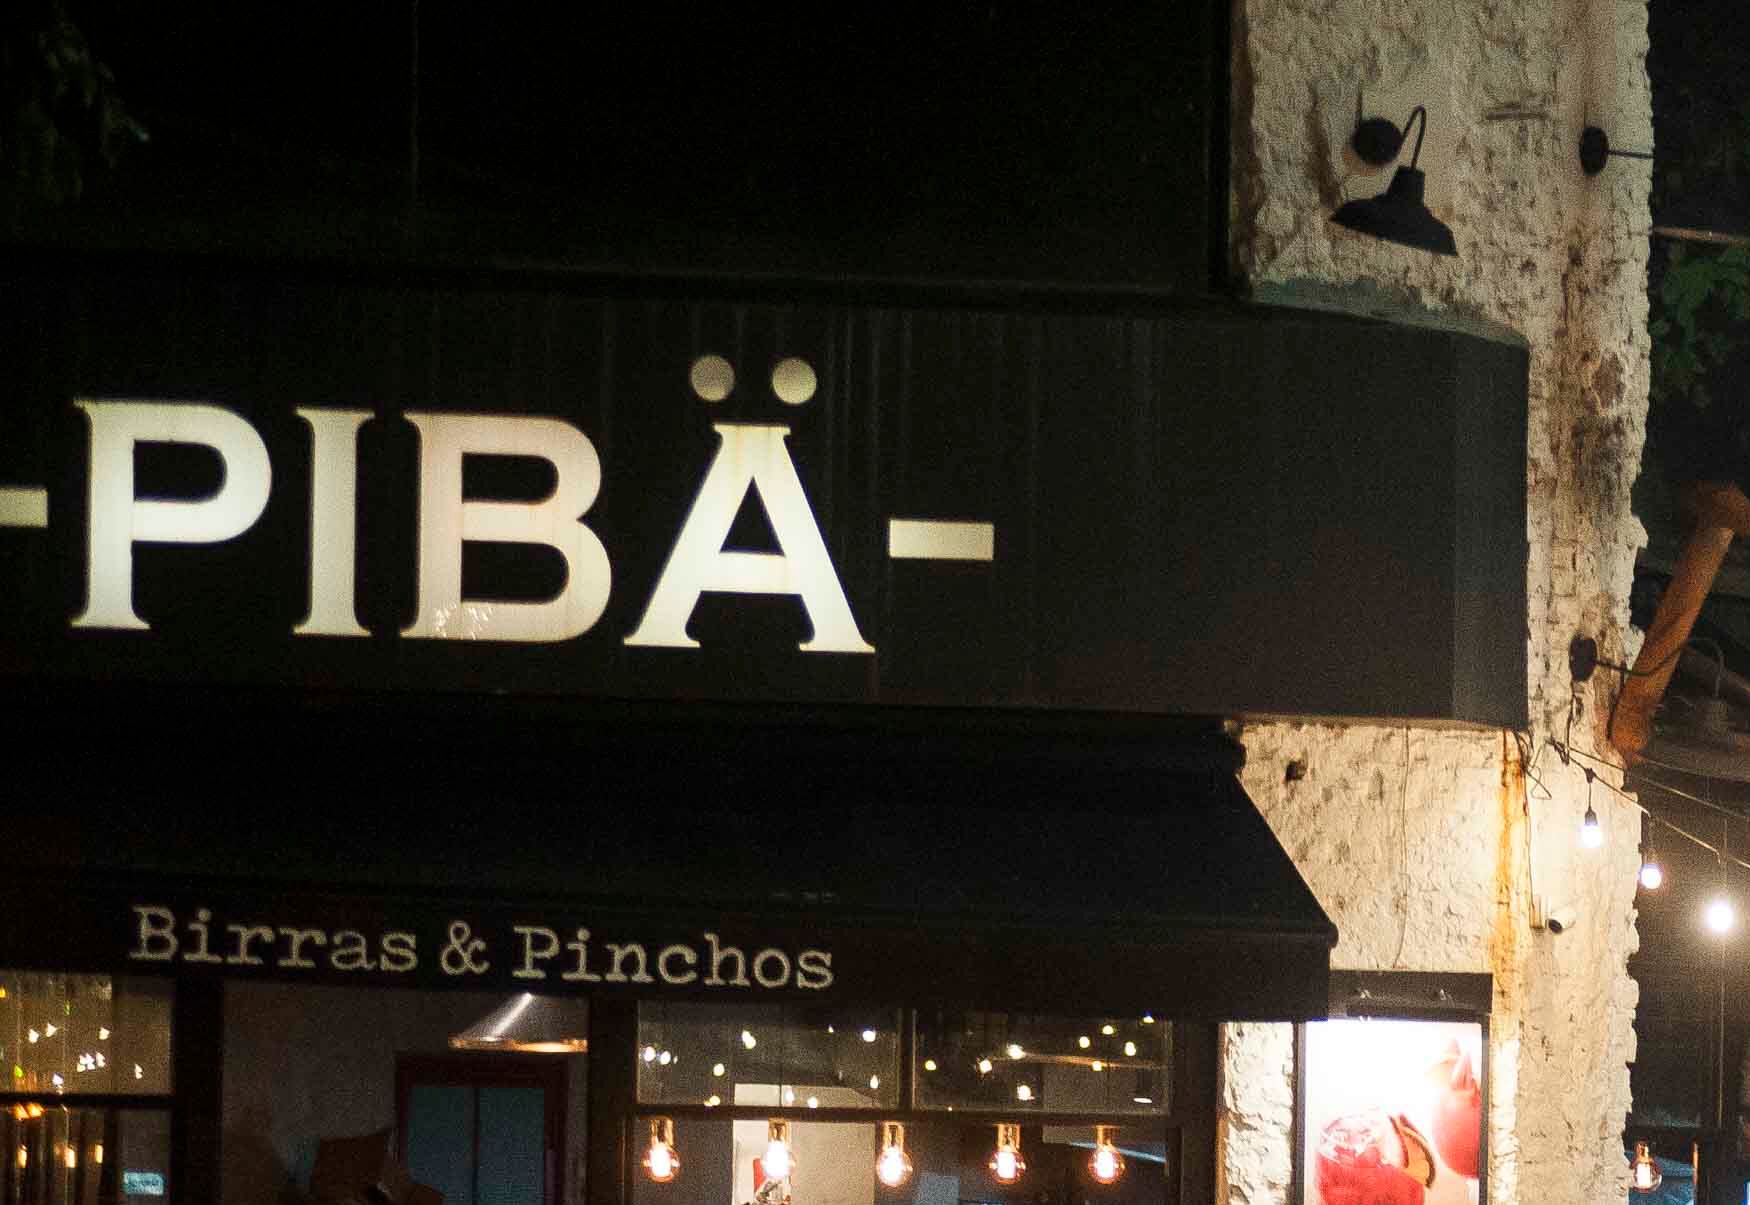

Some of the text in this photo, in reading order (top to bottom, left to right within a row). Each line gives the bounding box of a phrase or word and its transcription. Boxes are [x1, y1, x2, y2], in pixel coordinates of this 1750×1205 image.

[130, 905, 836, 989] Birras & Pinchos
